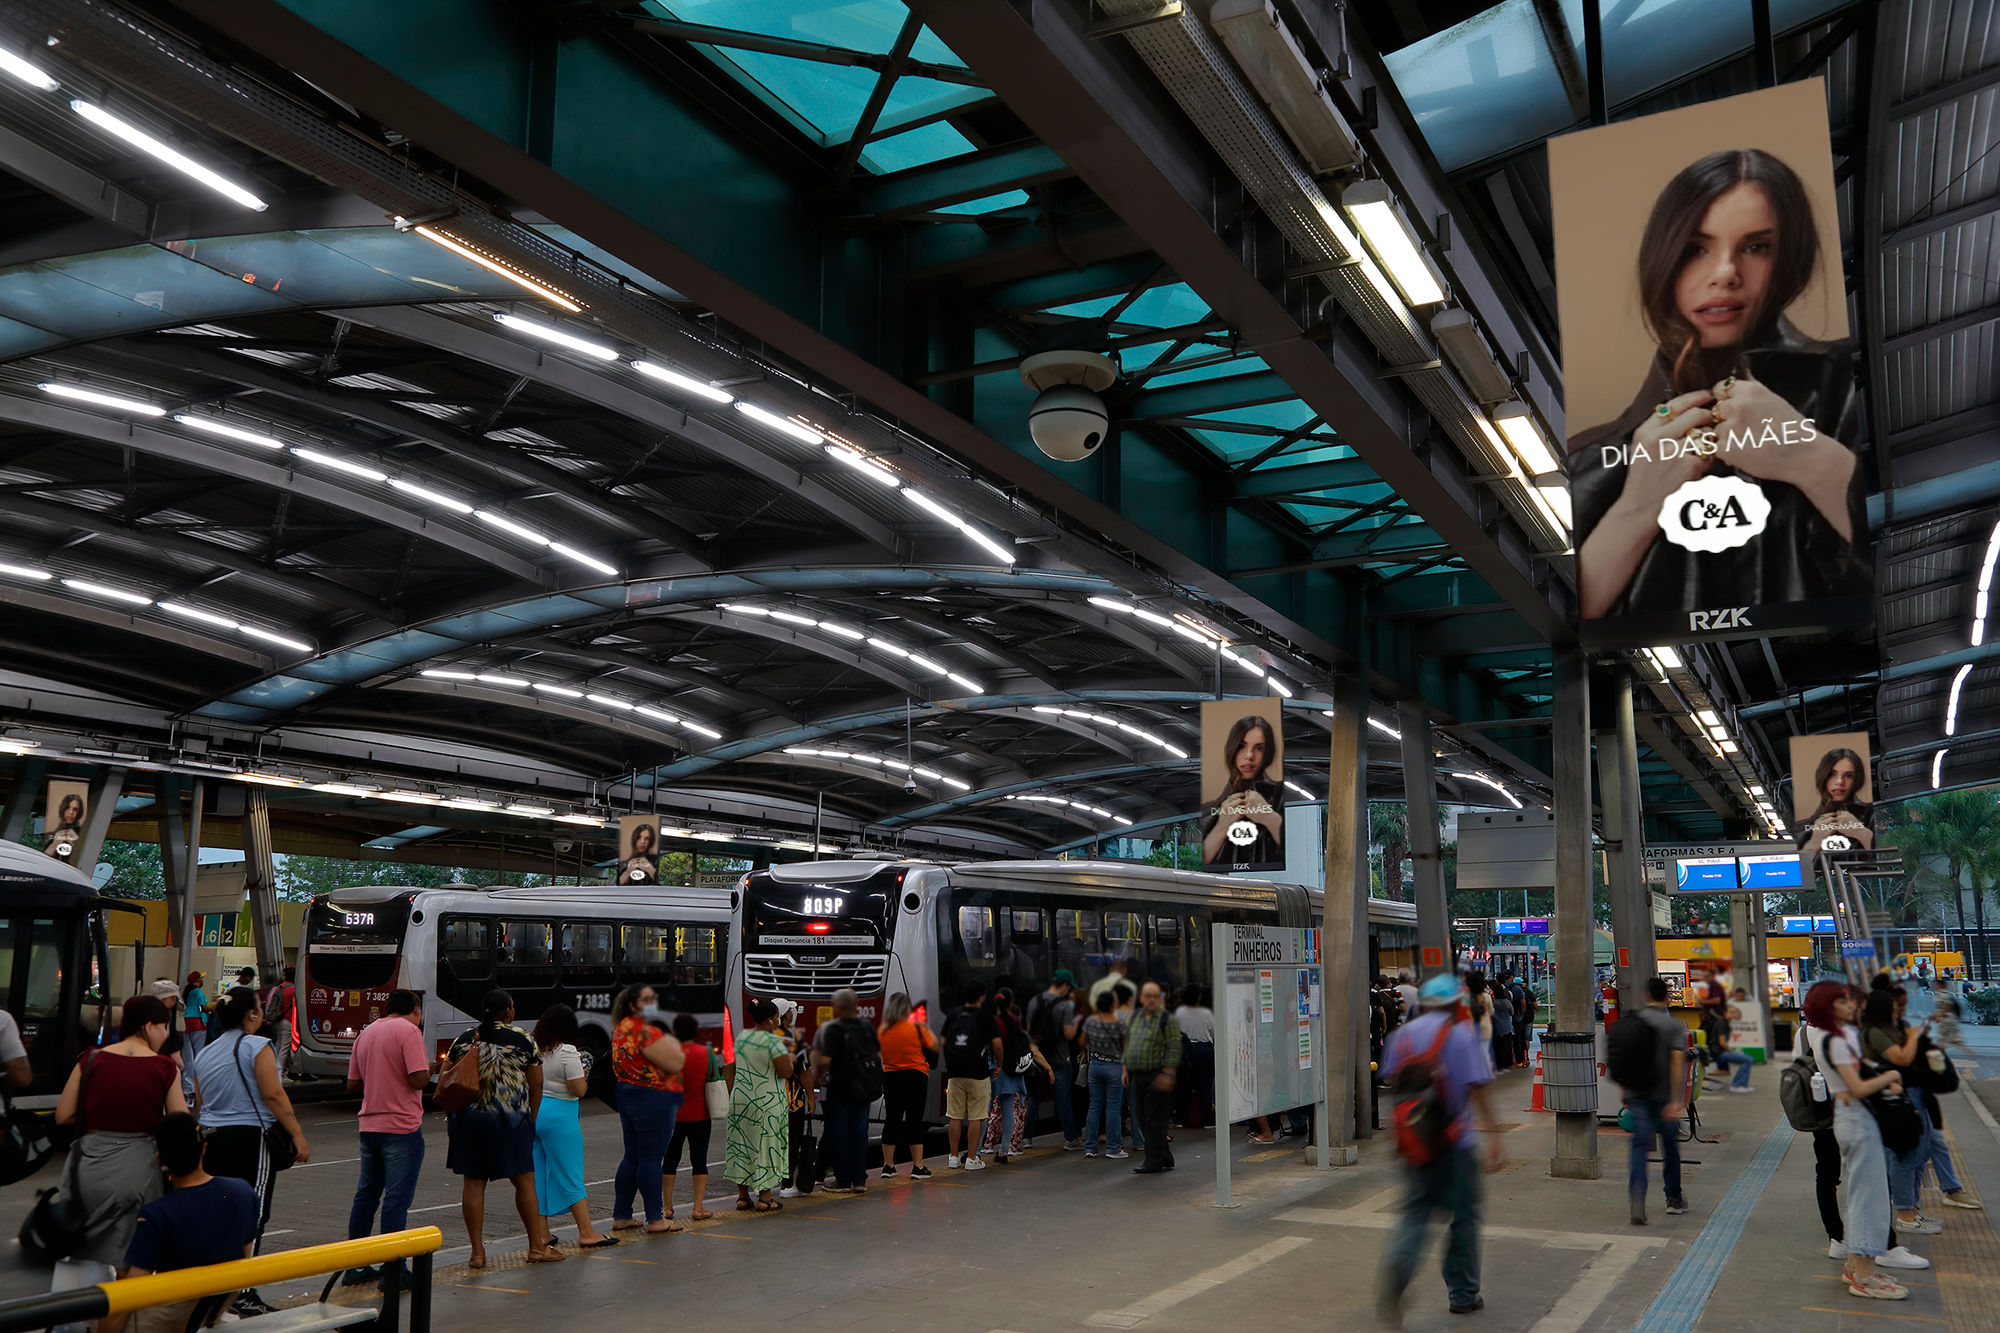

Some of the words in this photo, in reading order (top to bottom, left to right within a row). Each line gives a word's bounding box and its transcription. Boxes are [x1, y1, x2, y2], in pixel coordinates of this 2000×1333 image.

[1600, 441, 1653, 469] DIA
[1657, 431, 1719, 461] DAS
[1724, 417, 1818, 453] MÃES
[1679, 494, 1752, 532] C&A
[1689, 606, 1753, 632] RZK
[1210, 806, 1226, 817] DIA
[1227, 805, 1246, 815] DAS
[1246, 803, 1273, 815] MÃES
[1804, 823, 1820, 832] DIA
[1839, 820, 1865, 830] MÃES
[1232, 828, 1253, 838] C&A
[1233, 862, 1250, 870] RZK
[804, 897, 843, 914] 809P
[346, 912, 374, 925] 637A
[209, 930, 217, 943] 6
[225, 930, 233, 943] 2
[242, 931, 248, 943] 1
[1233, 925, 1265, 940] TERMINAL
[763, 936, 784, 944] Disque
[784, 936, 811, 944] Denúncia
[1234, 941, 1282, 962] PINHEIROS
[576, 994, 583, 1009] 7
[585, 994, 610, 1009] 3825
